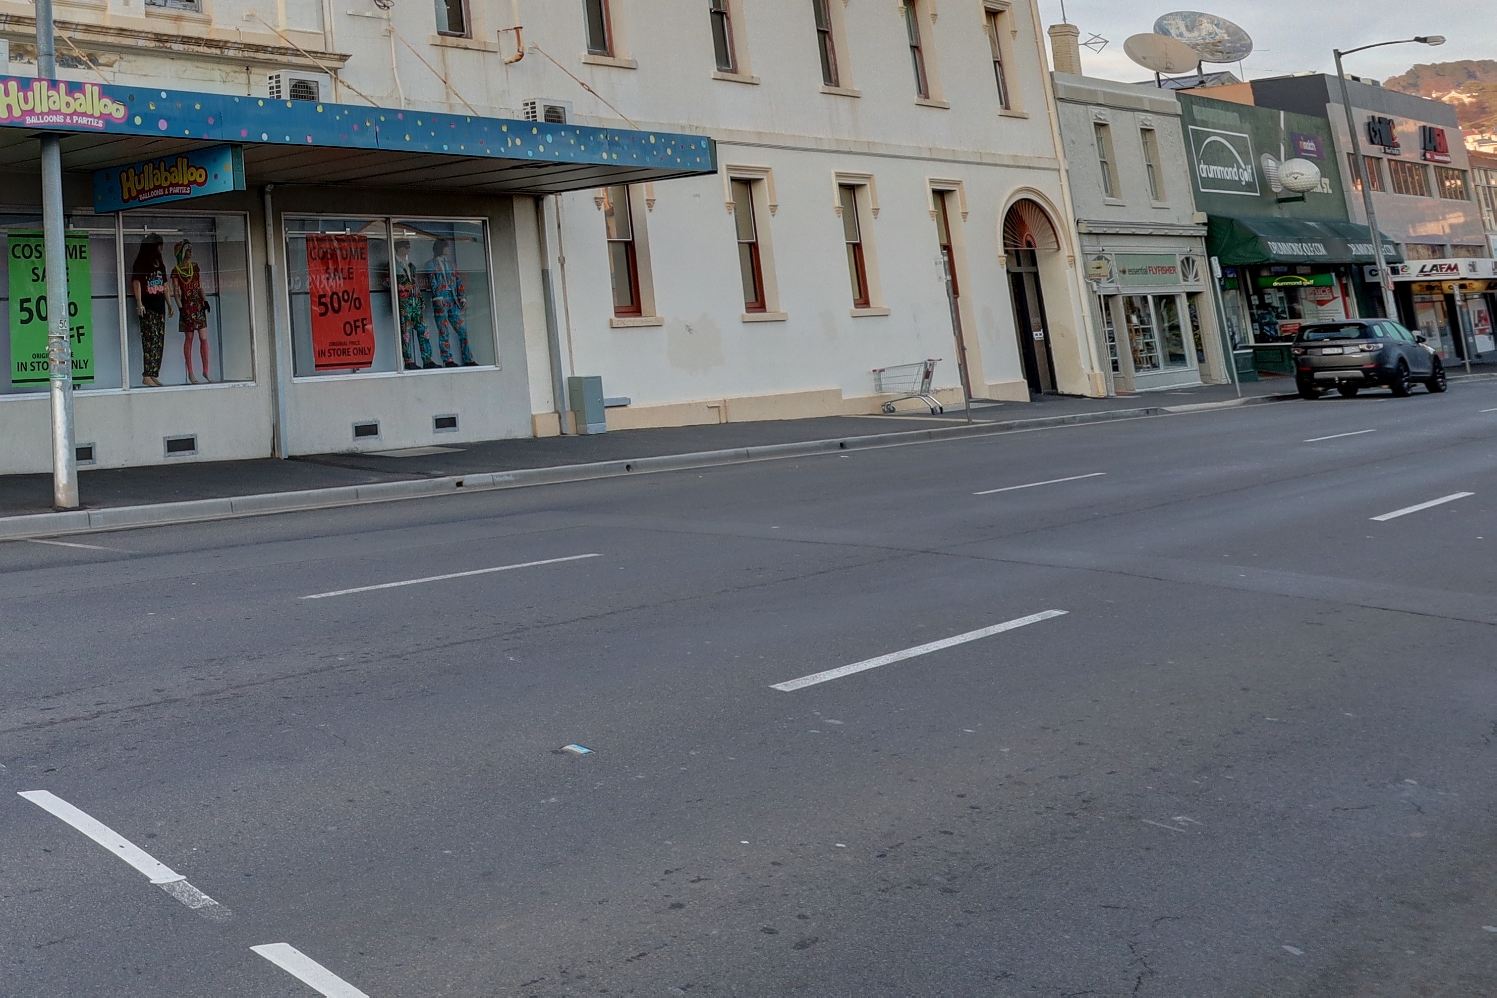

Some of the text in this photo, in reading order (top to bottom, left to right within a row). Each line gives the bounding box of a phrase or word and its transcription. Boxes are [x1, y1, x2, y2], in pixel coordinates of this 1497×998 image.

[25, 115, 64, 124] BALLOONS
[73, 116, 104, 128] PARTIES
[120, 157, 206, 200] Hullaballoo
[1199, 160, 1253, 185] drummond golf
[139, 189, 164, 201] BALLOONS
[169, 186, 191, 194] PARTIES
[11, 243, 88, 260] COSME
[309, 247, 367, 262] COSTUME
[325, 267, 354, 281] SALE
[1127, 265, 1177, 275] essential FLYFISHER
[1418, 263, 1459, 273] LAFM
[317, 288, 362, 318] 50%
[343, 318, 368, 337] OFF
[317, 347, 372, 358] IN STORE ONLY
[17, 359, 89, 372] IN STO NLY
